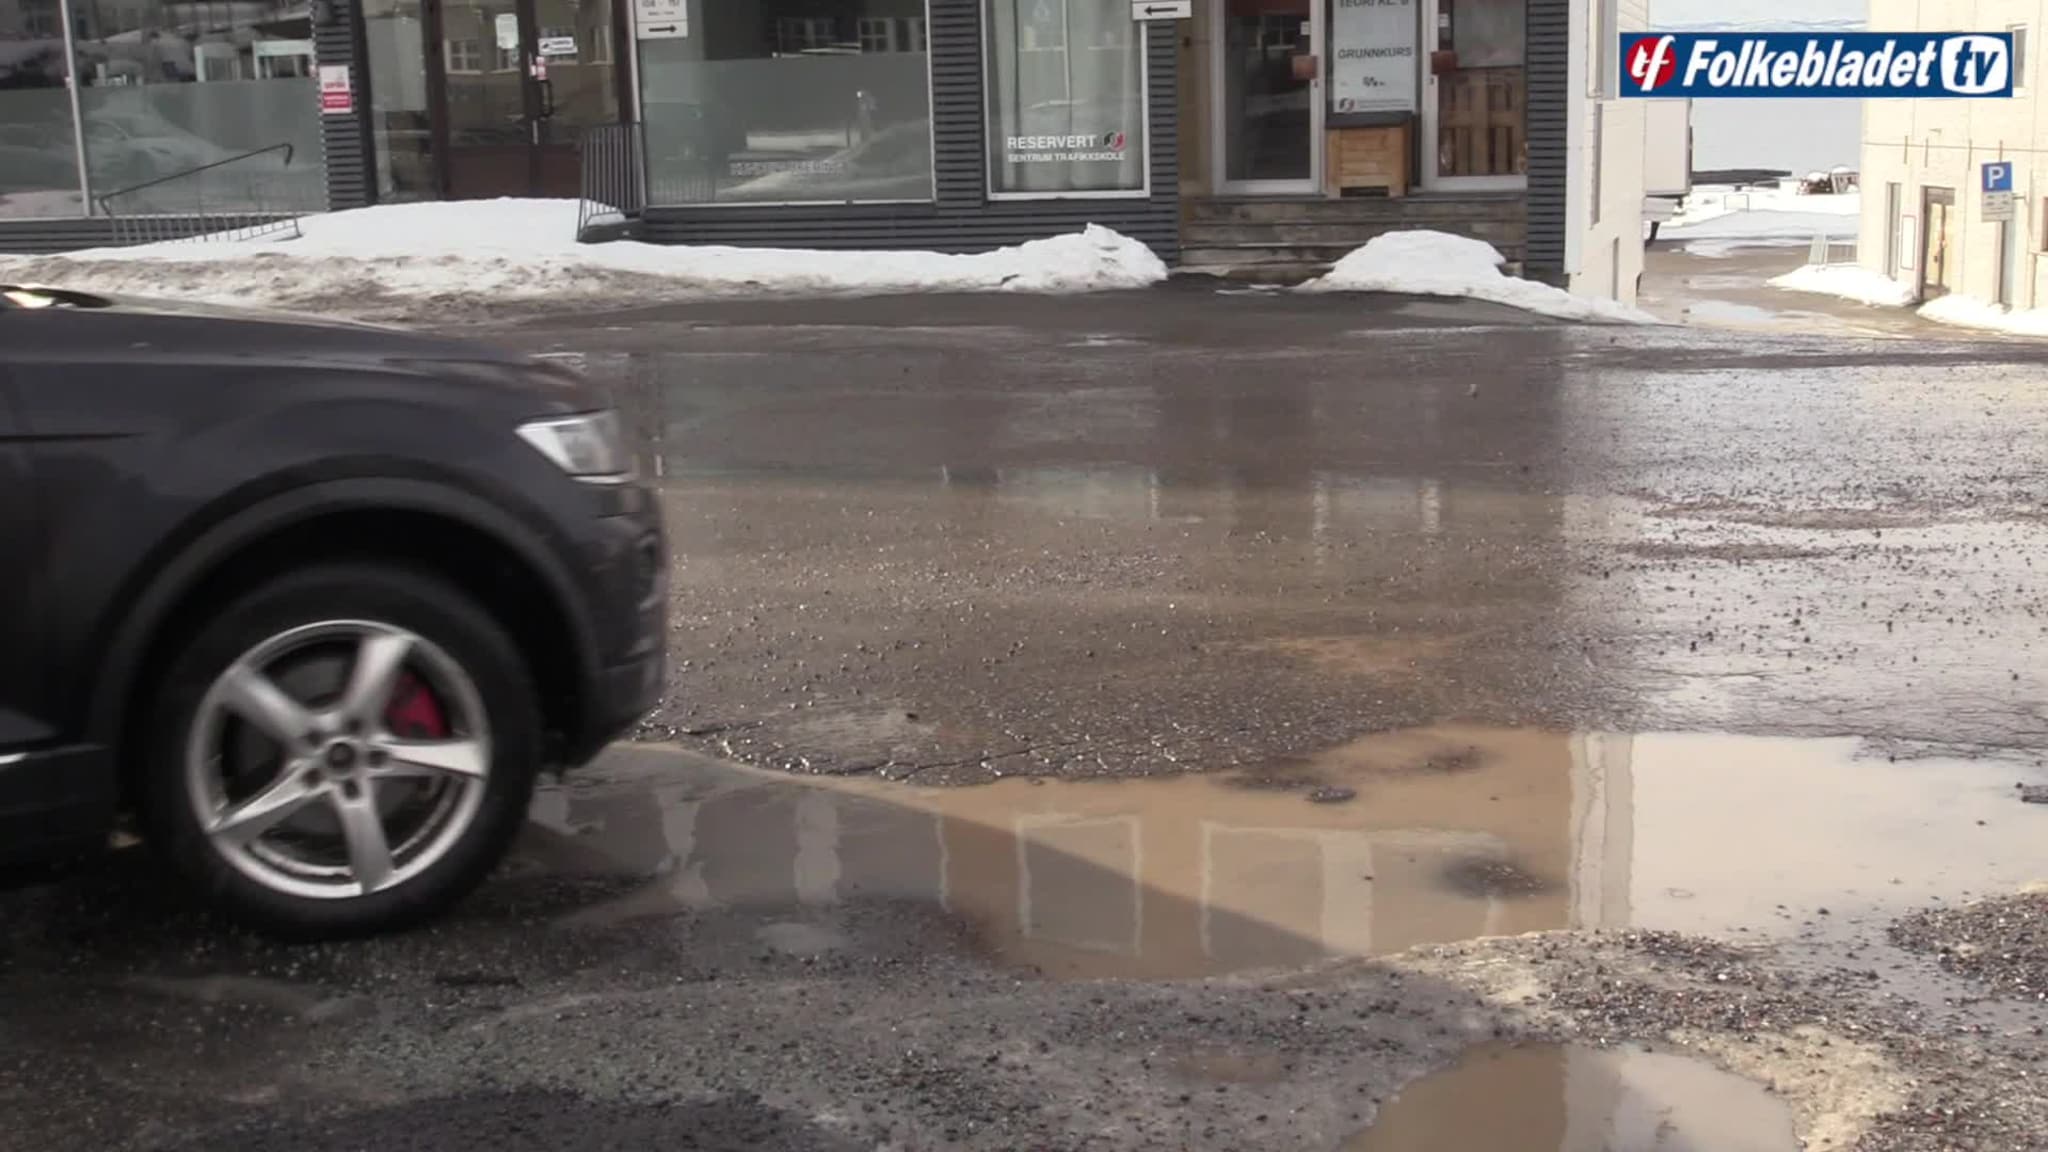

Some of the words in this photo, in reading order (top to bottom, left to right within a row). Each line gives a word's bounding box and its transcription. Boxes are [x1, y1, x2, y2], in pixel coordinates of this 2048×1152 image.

[1337, 46, 1413, 59] GRUNNKURS
[1007, 135, 1097, 149] RESERVERT
[1007, 153, 1053, 162] SENTRUM
[1988, 166, 2005, 189] P
